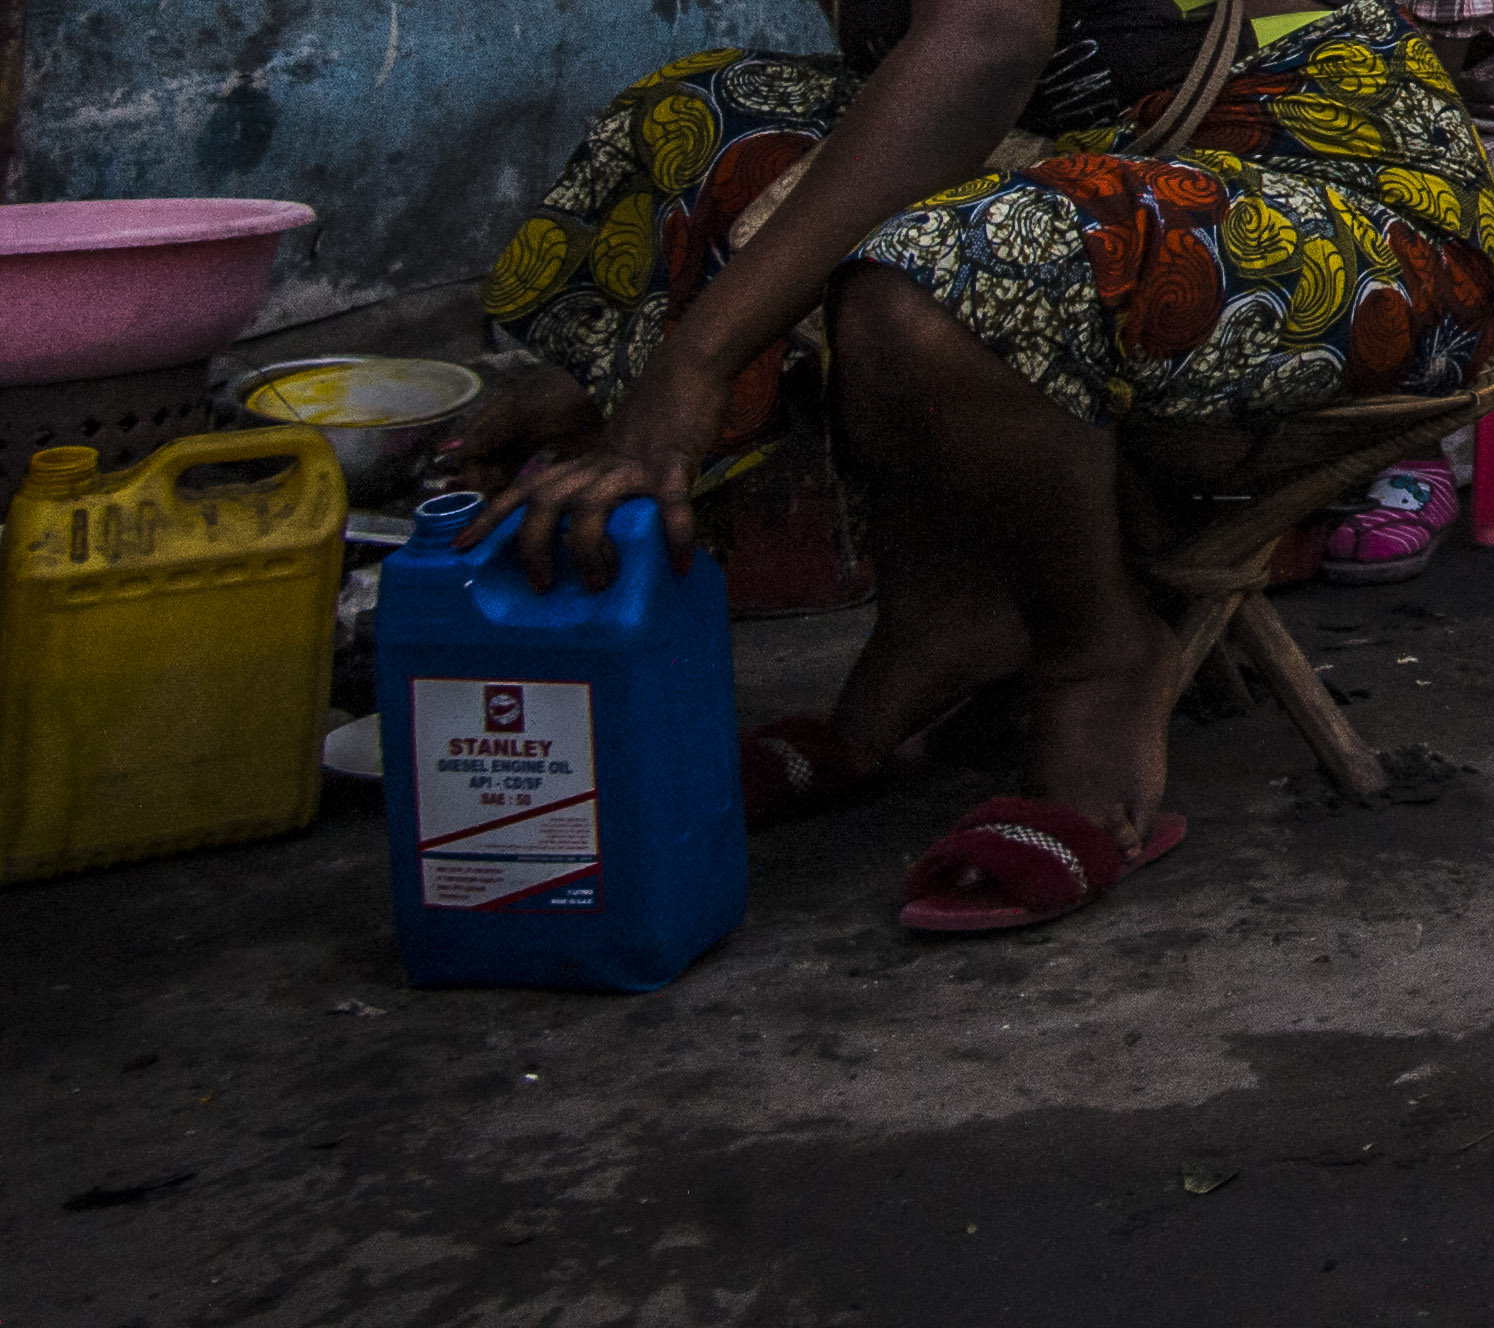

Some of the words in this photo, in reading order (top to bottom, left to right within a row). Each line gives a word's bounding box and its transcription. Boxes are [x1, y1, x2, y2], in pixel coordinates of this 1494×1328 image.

[449, 737, 553, 757] STANLEY
[437, 758, 488, 773] DIESEL
[490, 759, 546, 774] ENGINE
[548, 760, 574, 774] OIL
